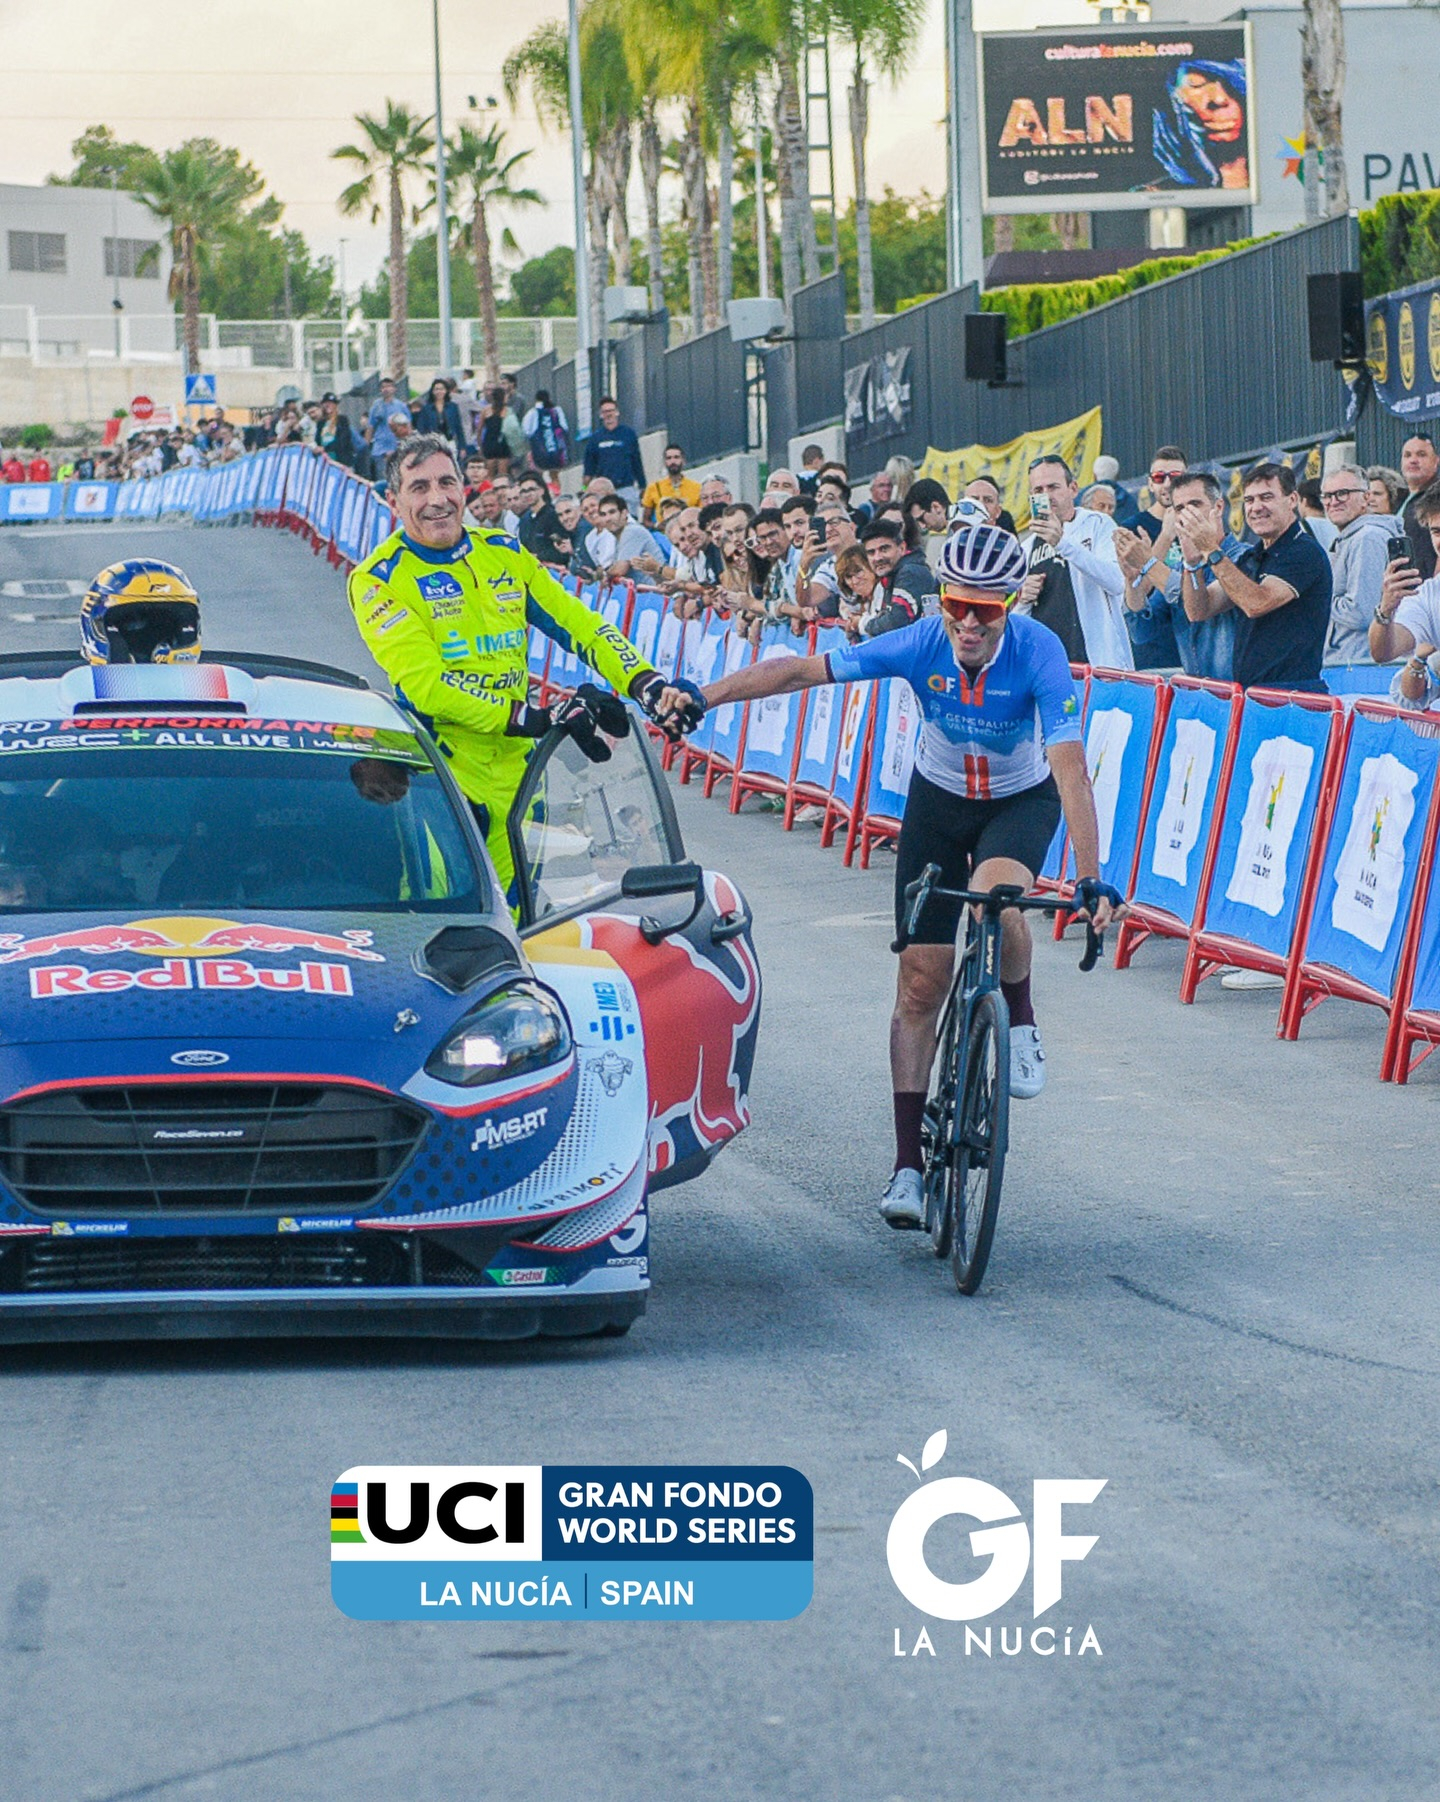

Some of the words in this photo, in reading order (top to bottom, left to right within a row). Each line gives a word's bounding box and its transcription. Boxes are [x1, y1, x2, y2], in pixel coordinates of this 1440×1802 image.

[998, 94, 1133, 146] ALN
[476, 628, 525, 654] IMED
[59, 716, 377, 739] PERFORMANCE
[154, 732, 215, 746] ALL
[222, 732, 291, 748] LIVE
[29, 958, 193, 999] Red
[199, 958, 354, 997] Bull
[592, 981, 620, 1012] IMED
[75, 1222, 128, 1233] MICHELIN
[300, 1217, 353, 1229] MICHELIN
[513, 1269, 544, 1282] Castrol
